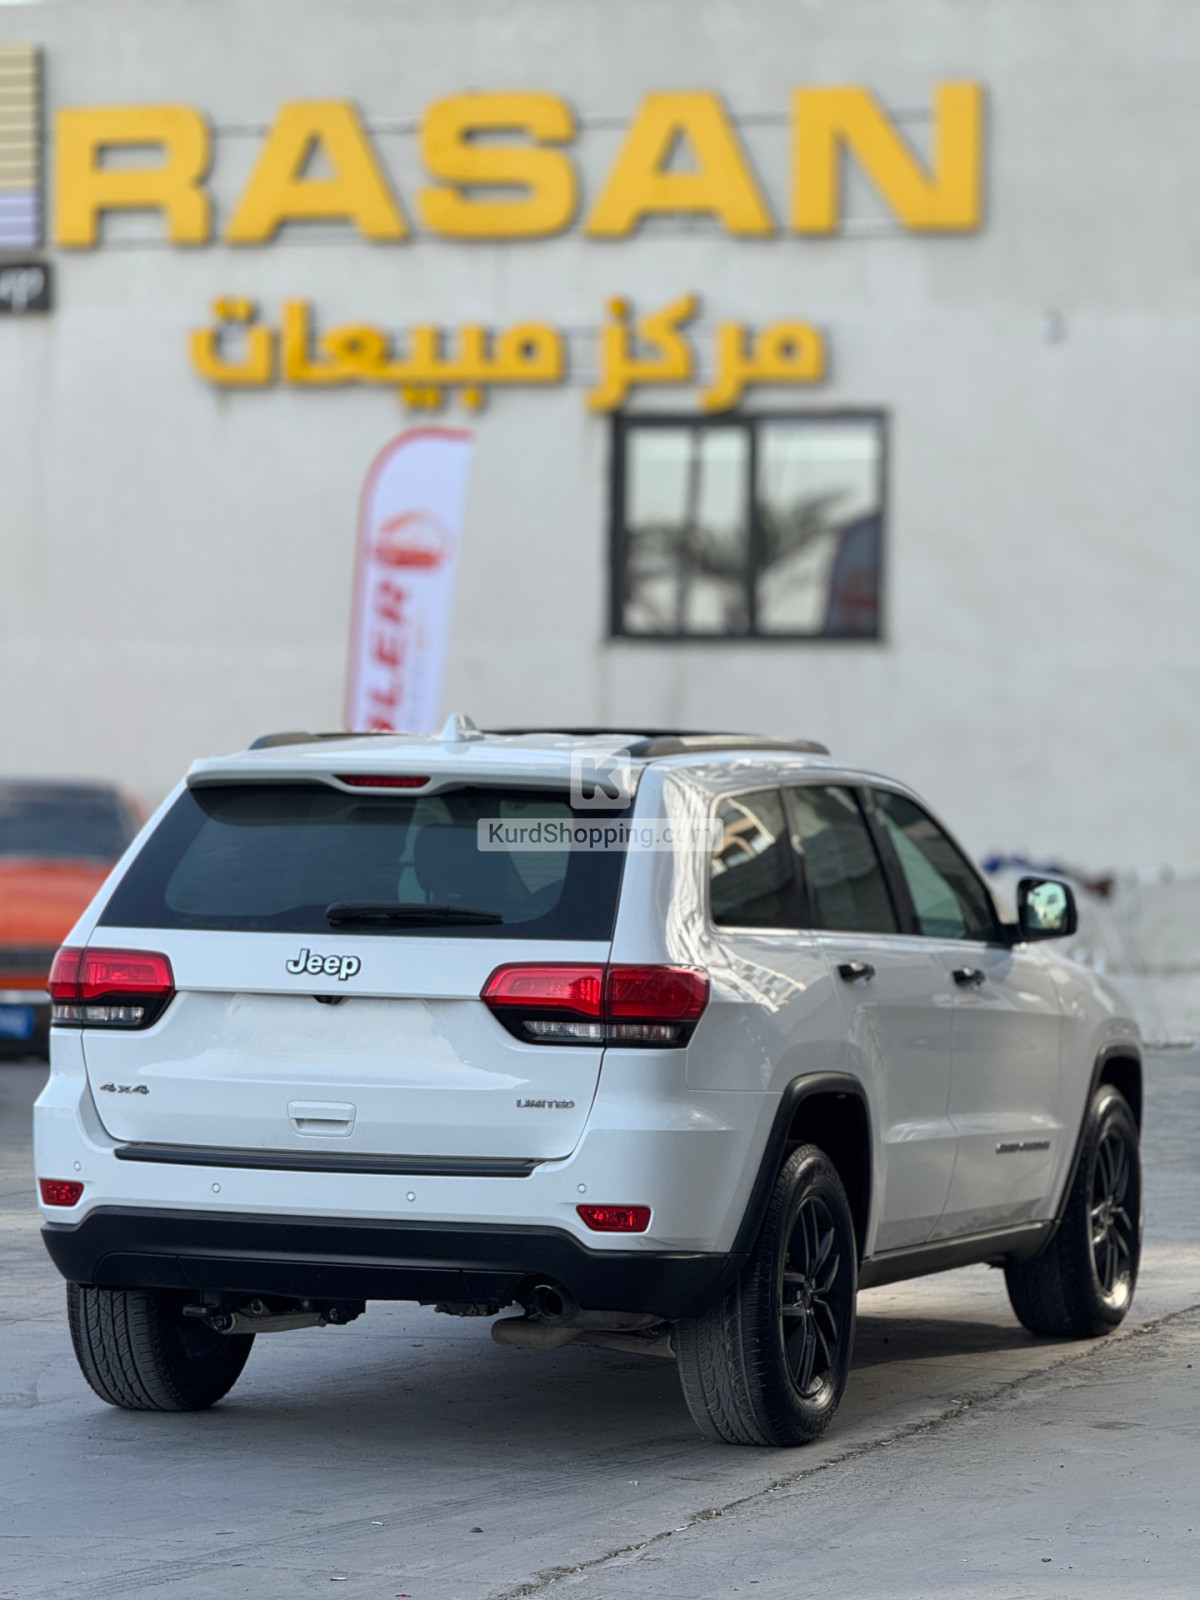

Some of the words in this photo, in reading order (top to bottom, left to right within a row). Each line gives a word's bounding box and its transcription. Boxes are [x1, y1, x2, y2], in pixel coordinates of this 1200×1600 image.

[52, 79, 982, 247] RASAN
[189, 295, 566, 410] مبيعات
[588, 293, 827, 411] مركز
[286, 948, 361, 981] Jeep
[516, 1099, 575, 1109] LIMITED
